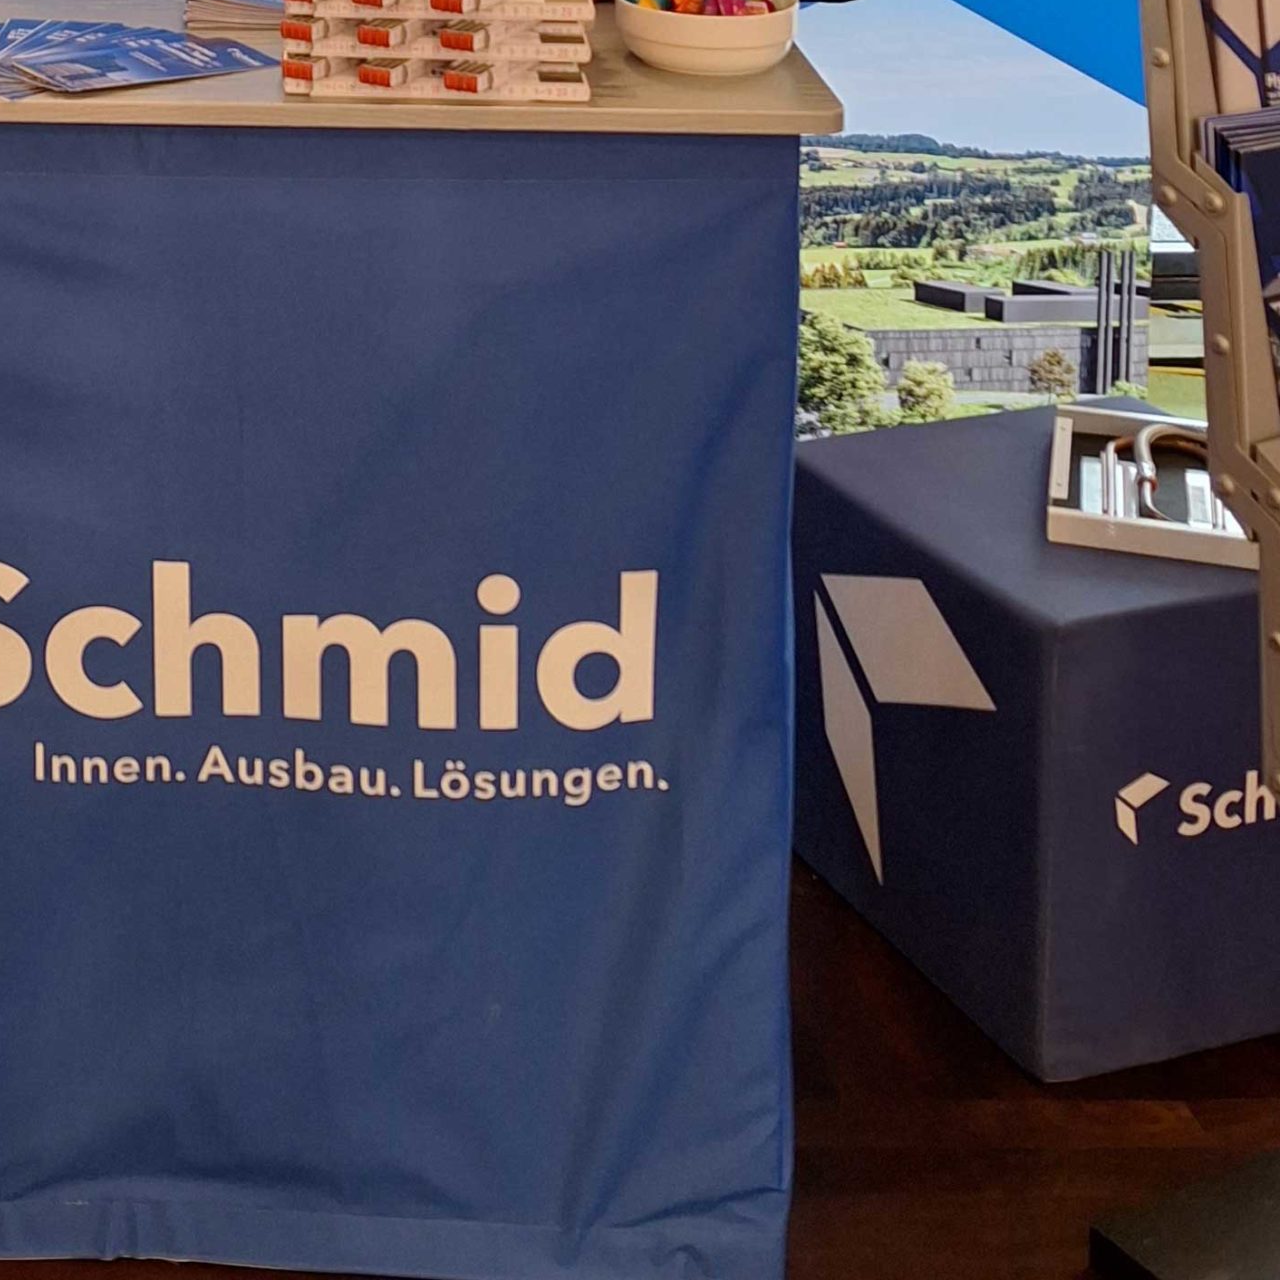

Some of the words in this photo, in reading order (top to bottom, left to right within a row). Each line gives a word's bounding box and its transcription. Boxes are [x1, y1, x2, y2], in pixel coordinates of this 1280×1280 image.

[33, 741, 187, 785] Innen.
[198, 745, 402, 797] Ausbau.
[412, 757, 670, 807] Lösungen.
[1177, 770, 1277, 836] Sch
